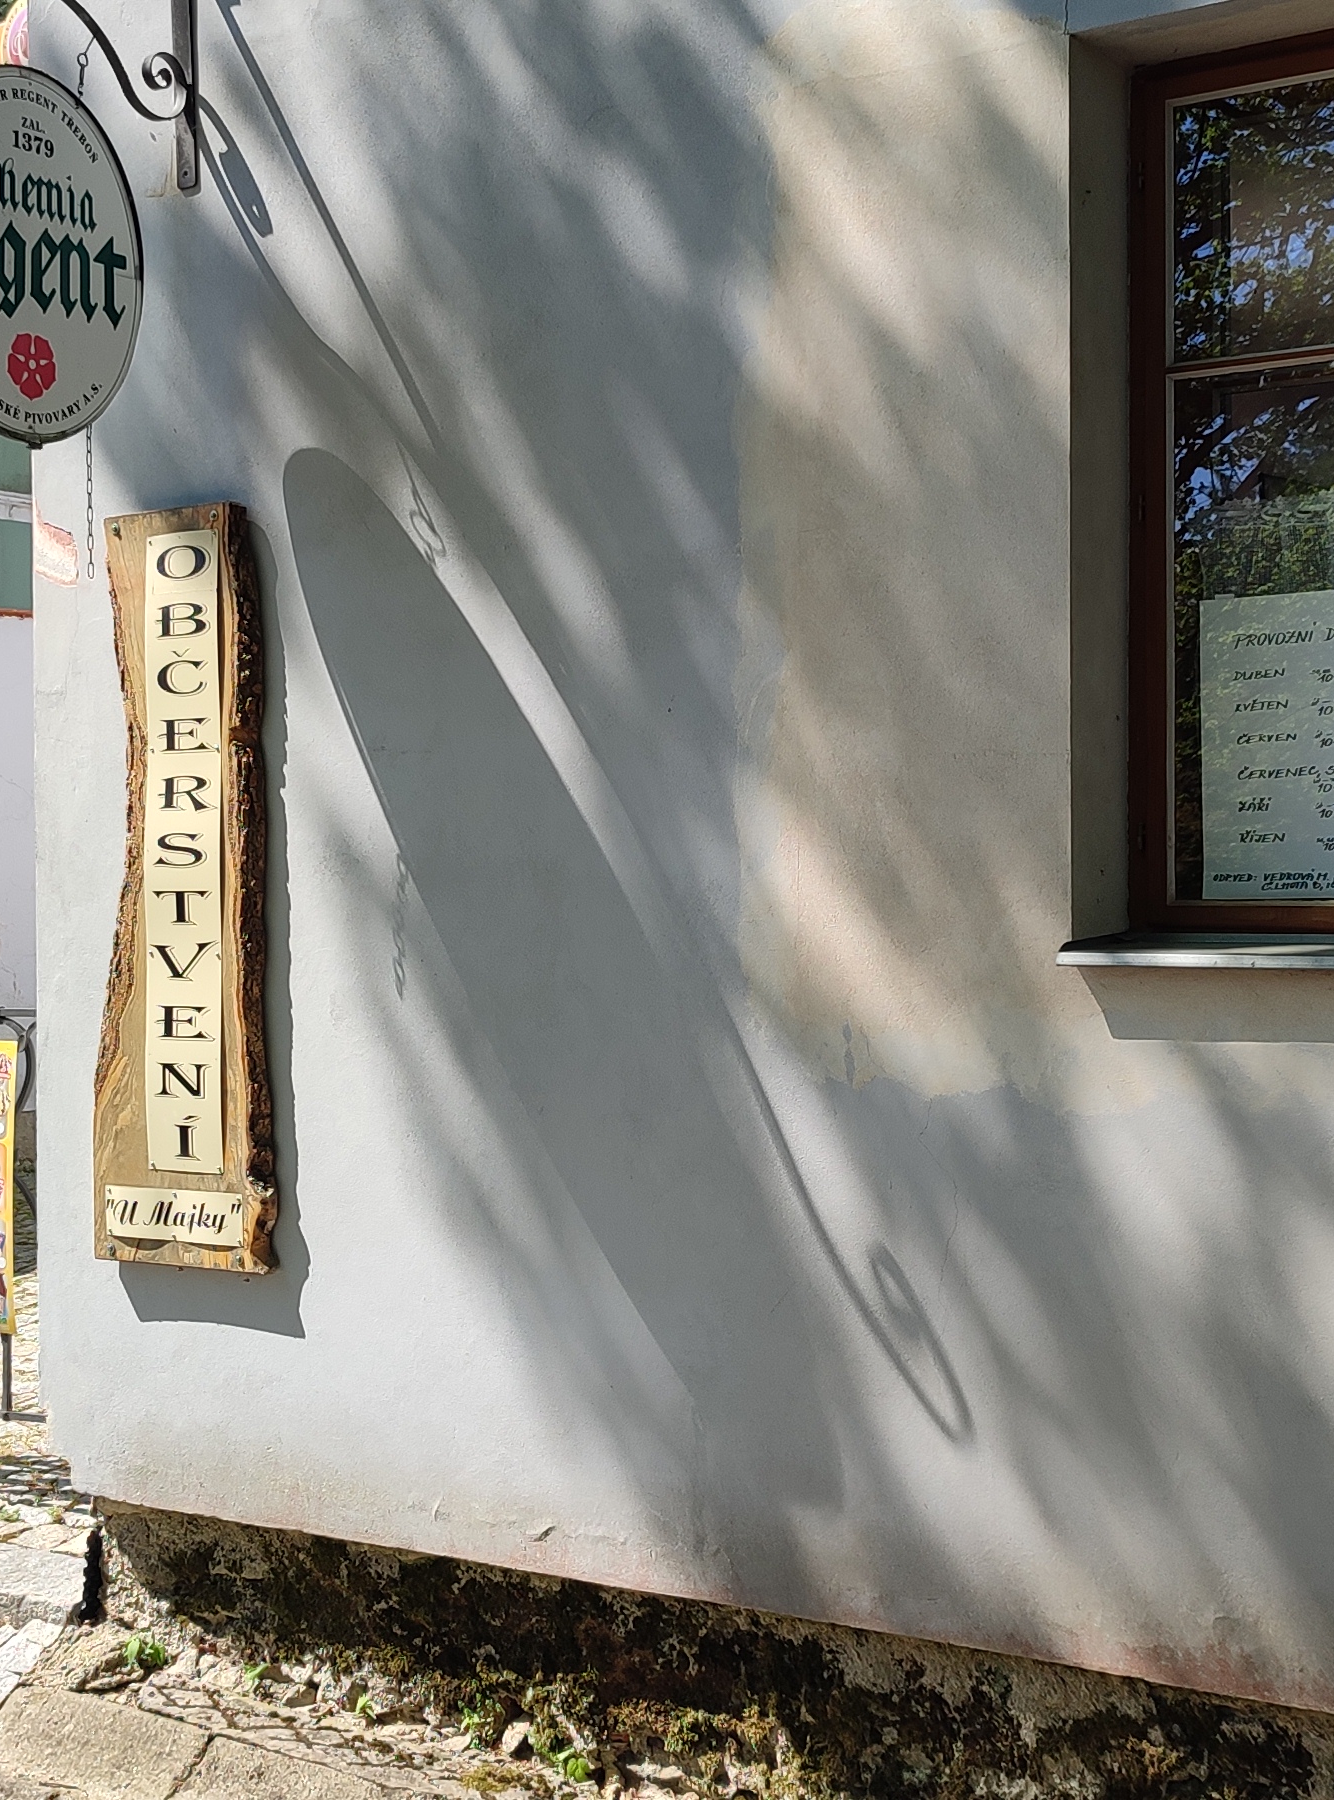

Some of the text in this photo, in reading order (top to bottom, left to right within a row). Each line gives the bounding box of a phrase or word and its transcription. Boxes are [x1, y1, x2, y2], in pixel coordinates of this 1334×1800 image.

[11, 88, 59, 114] REGENT
[21, 116, 46, 134] ZAL.
[12, 130, 55, 158] 1379
[24, 400, 82, 424] PIVOVARY
[82, 382, 103, 406] A.S.
[1233, 622, 1317, 649] PROVOZNÍ
[1233, 668, 1285, 681] DUBEN
[1235, 698, 1289, 712] KVĚTEN
[1237, 733, 1297, 745] ČERVEN
[1237, 766, 1321, 780] ČERVENEC,
[1239, 830, 1285, 844] ŘÍJEN
[154, 543, 215, 1162] OBČERSTVENÍ
